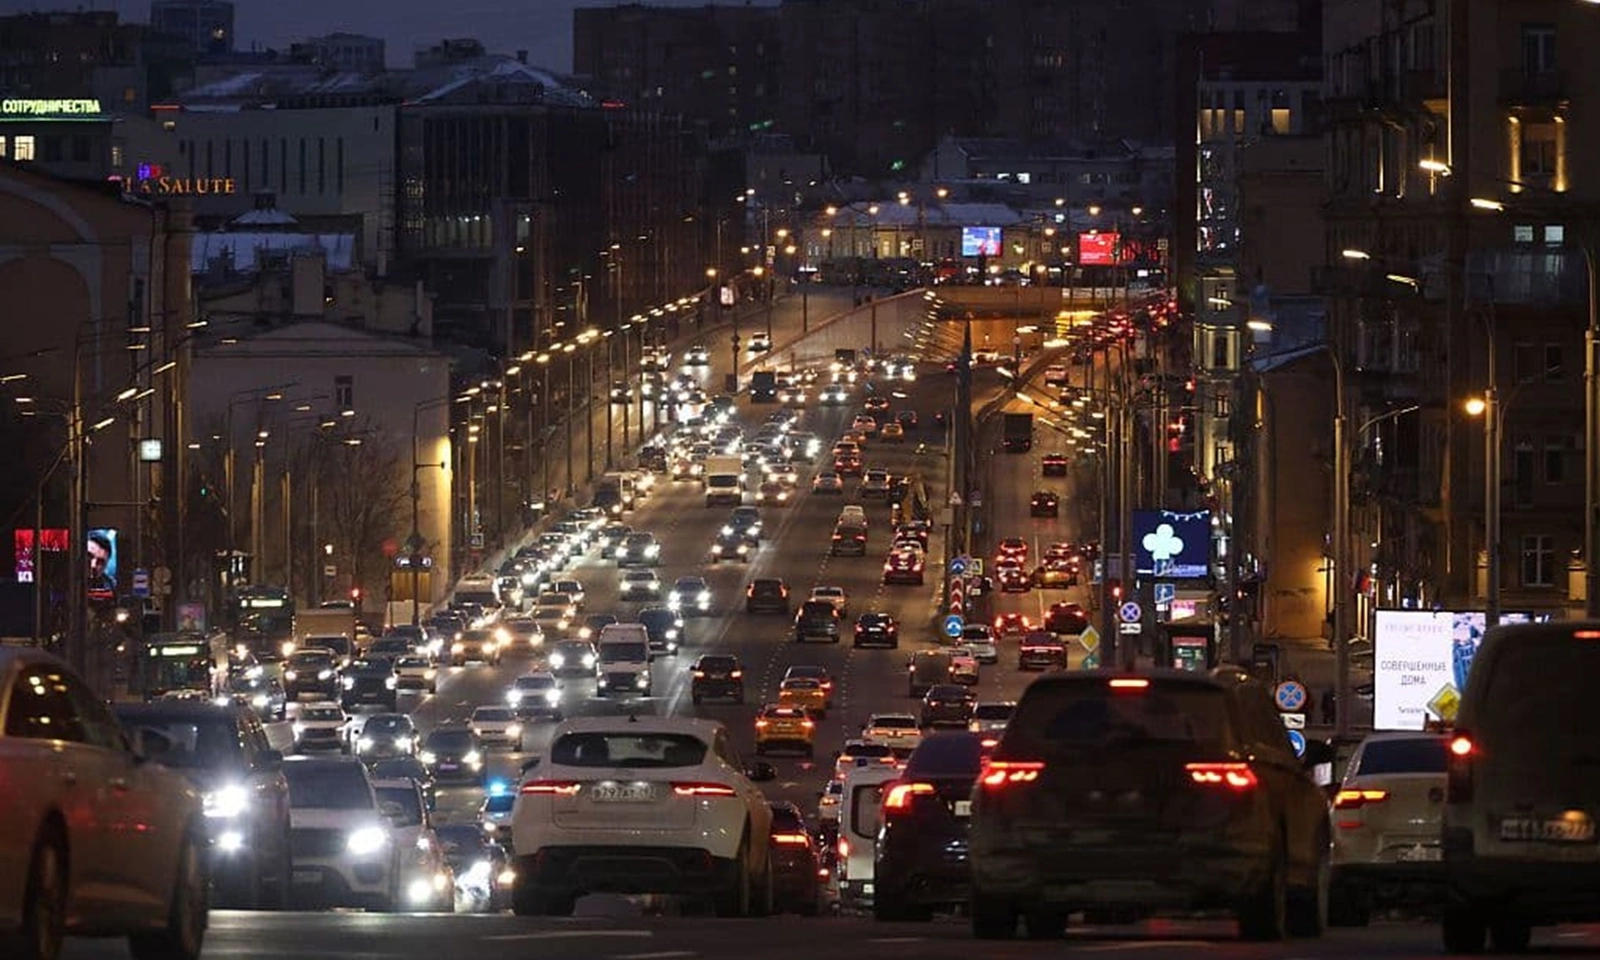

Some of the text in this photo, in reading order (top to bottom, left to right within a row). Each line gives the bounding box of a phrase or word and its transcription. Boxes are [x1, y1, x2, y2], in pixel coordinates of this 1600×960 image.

[3, 99, 101, 115] СОТРУДНИЧЕСТВА
[1380, 660, 1446, 671] СОВЕРШЕННЫЕ
[1400, 675, 1426, 685] ДОМА
